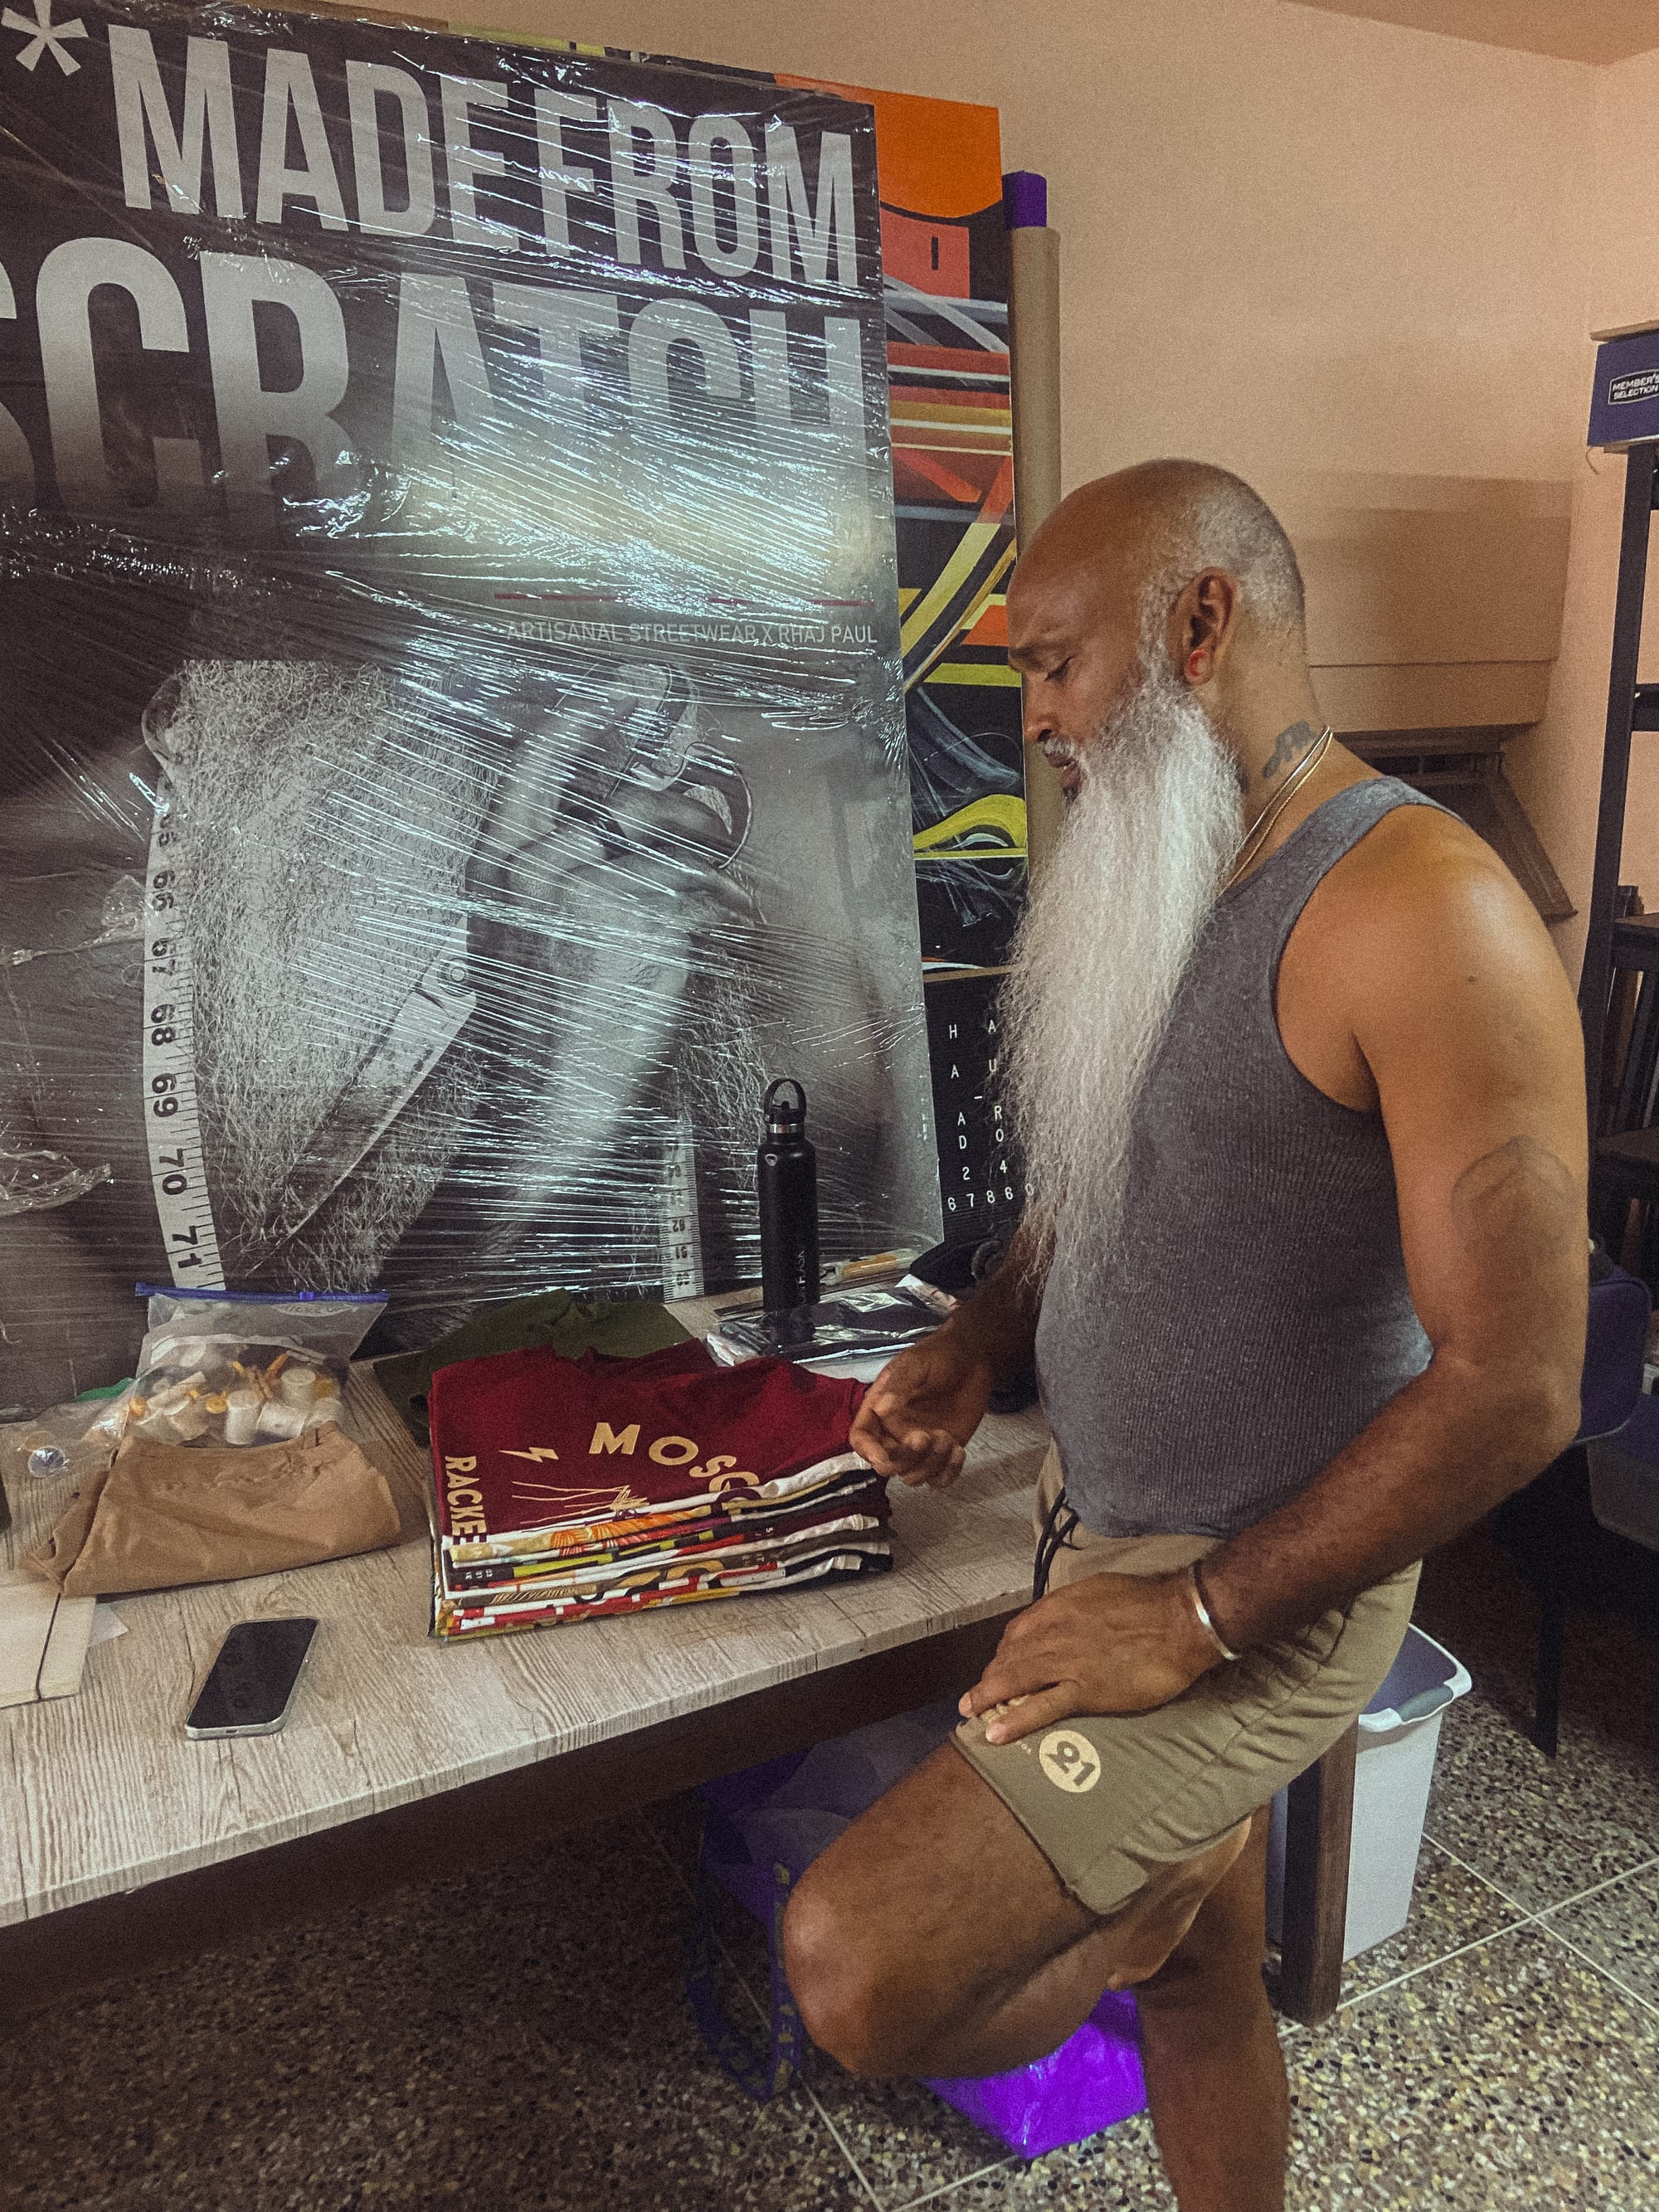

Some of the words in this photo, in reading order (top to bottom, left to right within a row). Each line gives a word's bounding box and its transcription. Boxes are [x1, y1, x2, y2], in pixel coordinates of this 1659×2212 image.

[534, 86, 859, 289] FROM
[1613, 373, 1659, 391] MEMBER'S
[1613, 385, 1658, 400] SELECTION
[0, 236, 873, 585] CRATCH
[505, 620, 624, 644] ARTISANAL
[628, 623, 757, 644] STREETWEAR
[763, 625, 773, 644] X
[778, 625, 825, 645] RHAJ
[831, 625, 878, 645] PAUL
[151, 937, 177, 976] 67
[151, 1004, 176, 1045] 68
[151, 1072, 178, 1117] 69
[158, 1148, 187, 1195] 70
[172, 1225, 202, 1268] 71
